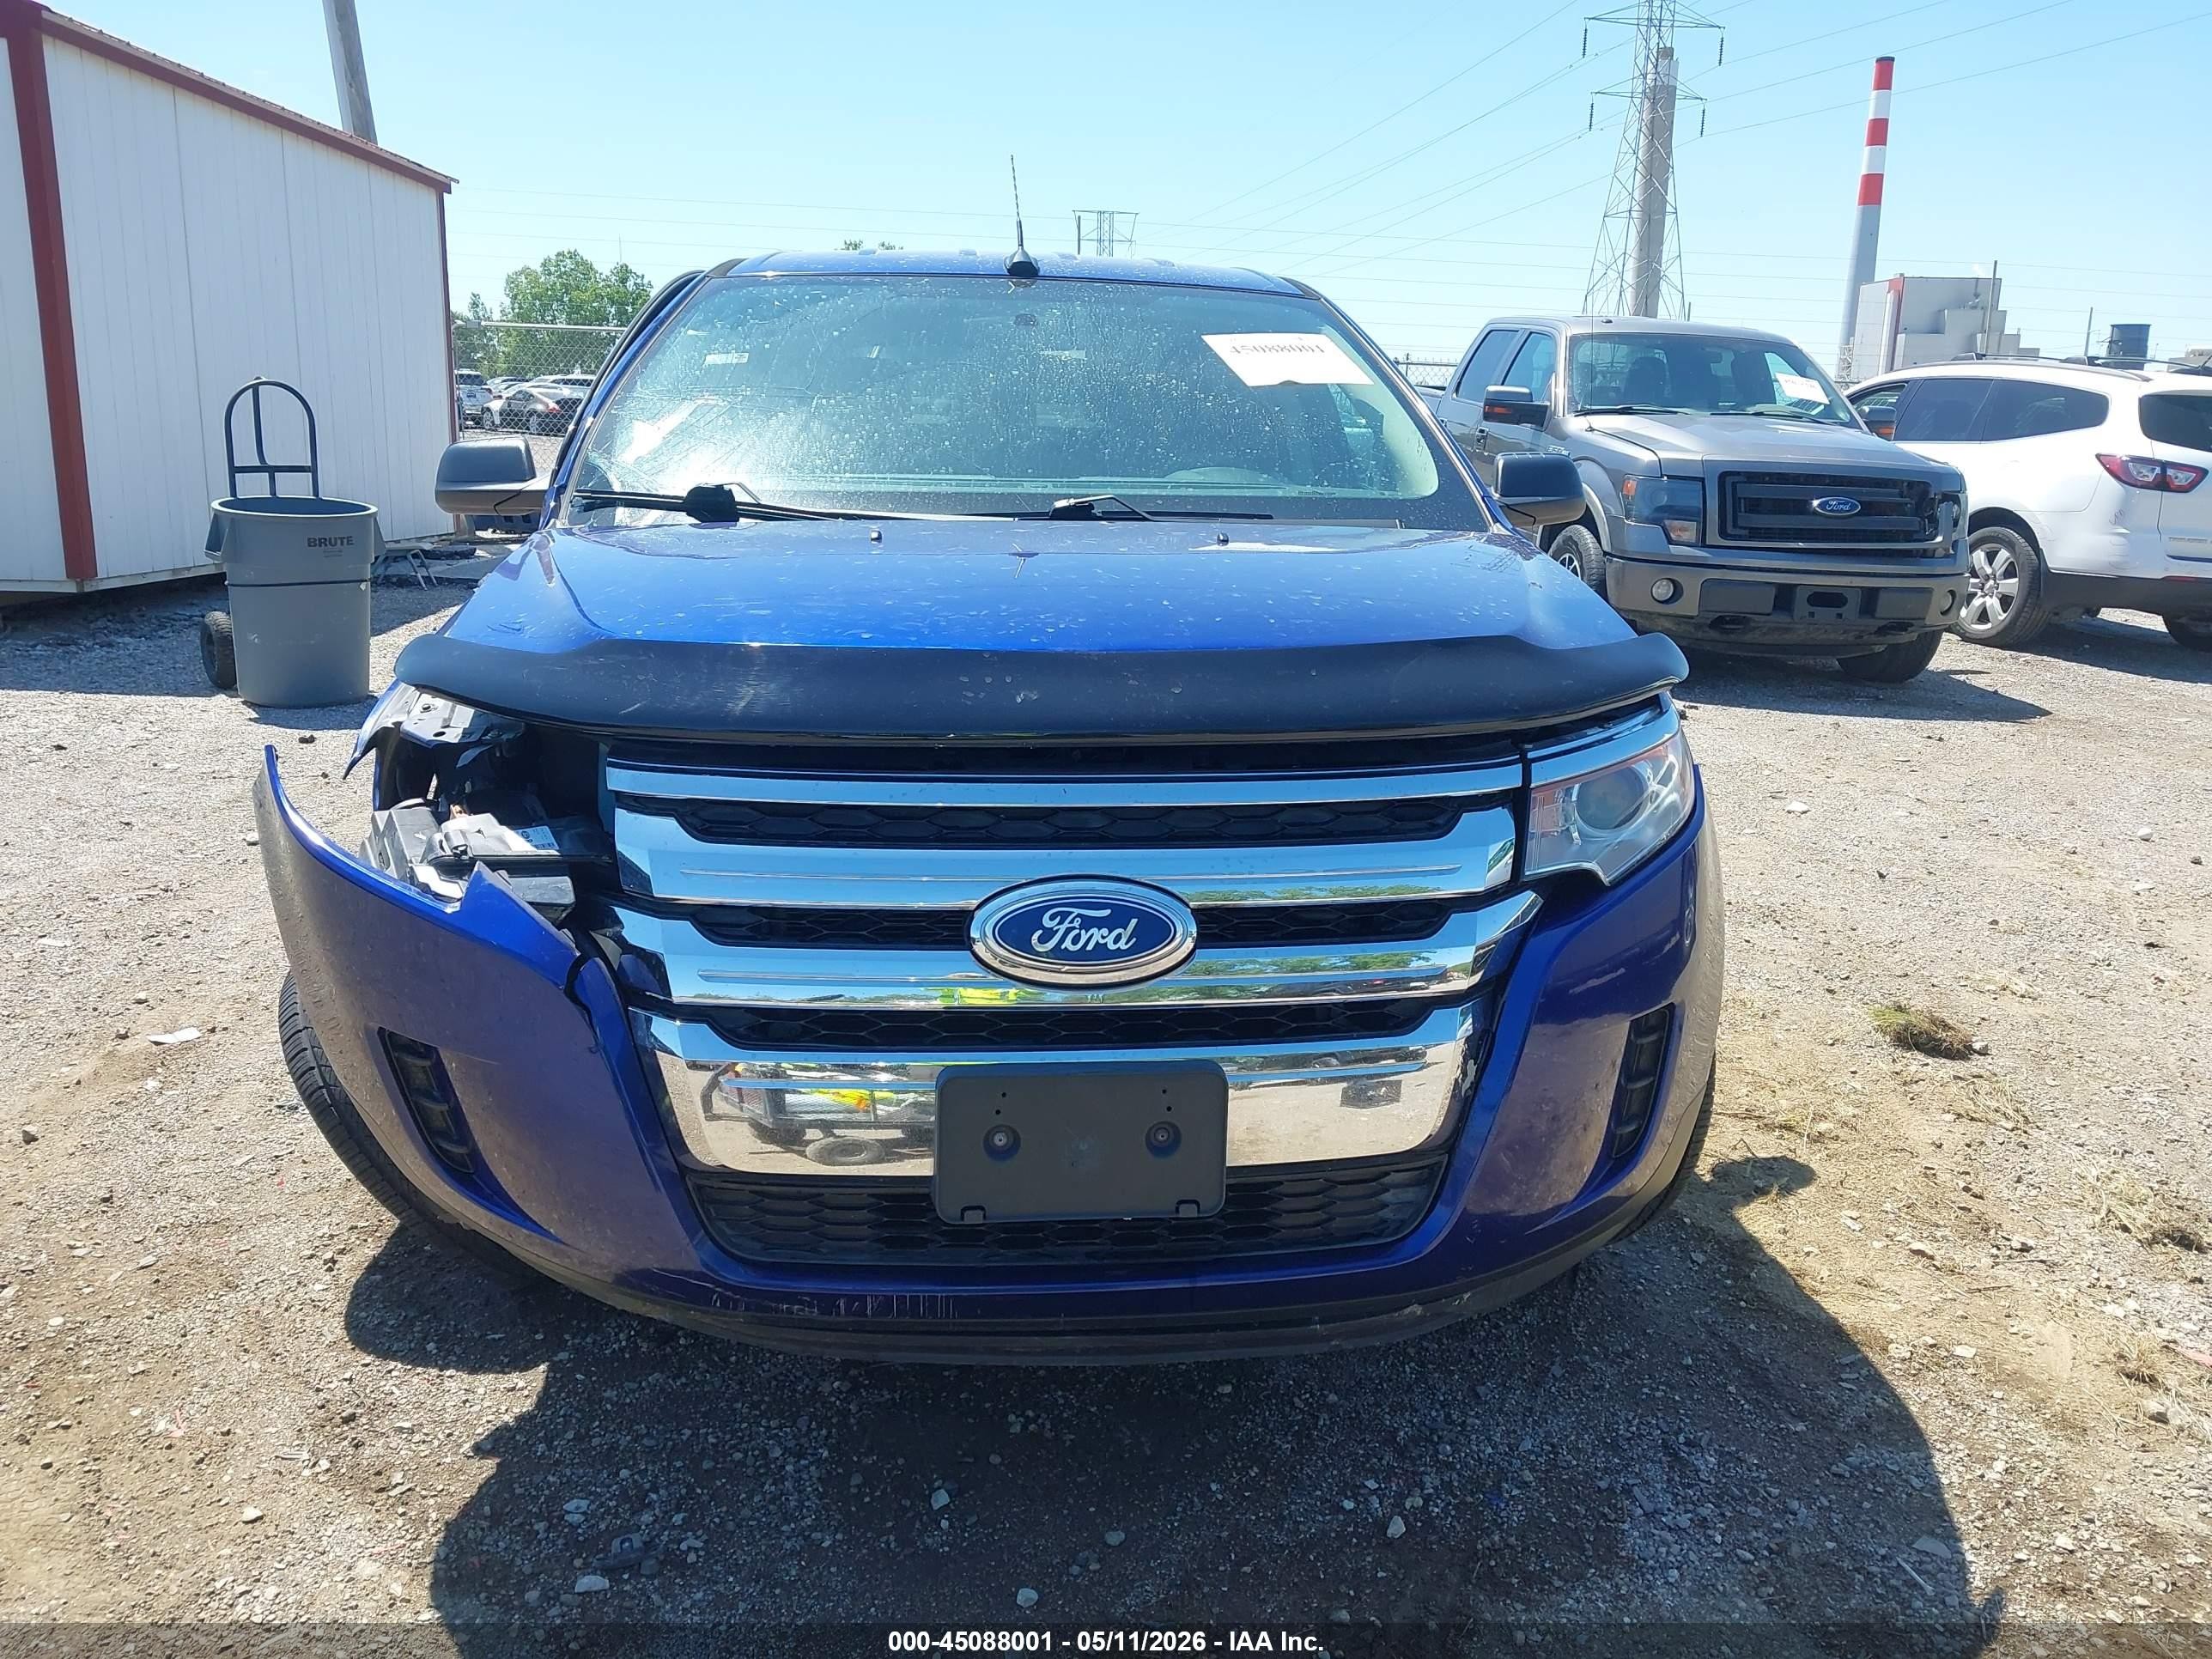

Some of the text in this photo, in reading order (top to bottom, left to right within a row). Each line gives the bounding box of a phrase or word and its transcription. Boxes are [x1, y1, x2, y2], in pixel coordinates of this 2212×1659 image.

[1826, 500, 1851, 511] Ford
[307, 535, 355, 548] BRUTE
[1030, 906, 1139, 952] Ford
